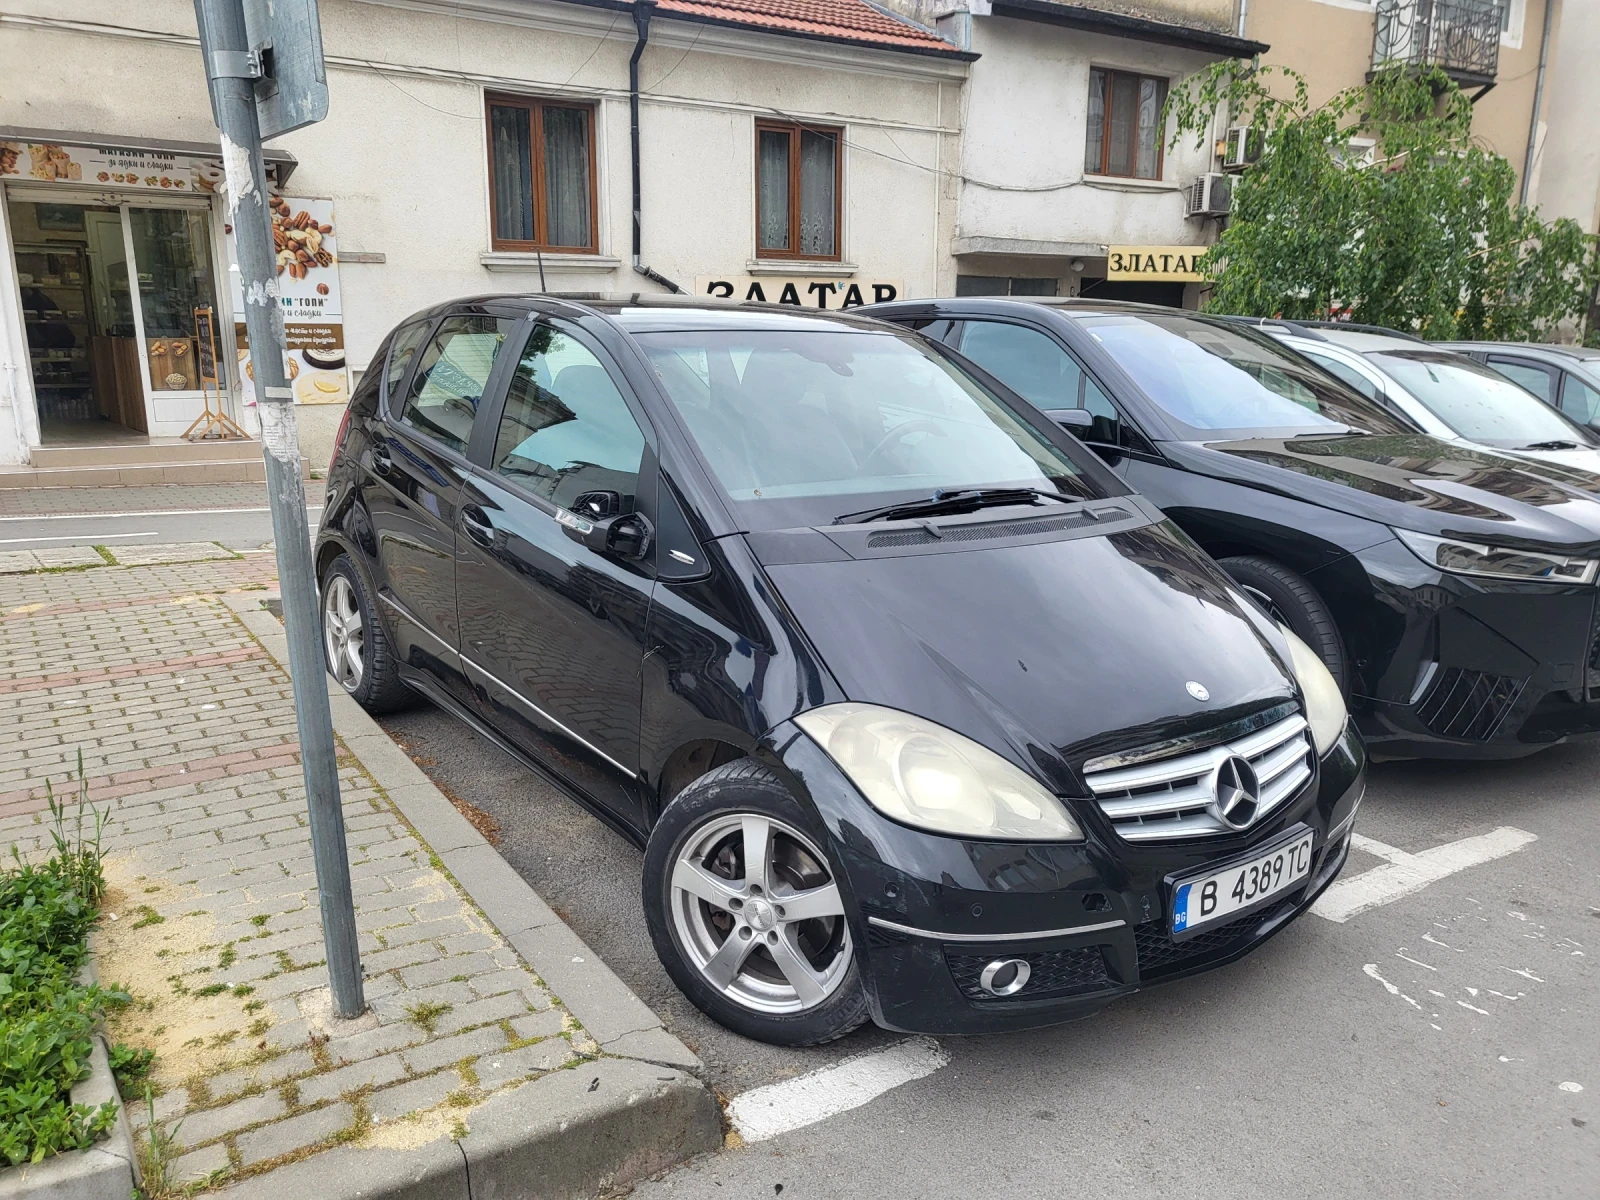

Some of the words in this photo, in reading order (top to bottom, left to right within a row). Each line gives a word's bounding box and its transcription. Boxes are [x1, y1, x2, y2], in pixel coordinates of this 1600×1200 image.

[119, 159, 138, 170] ядки
[147, 161, 174, 172] сладки
[294, 309, 322, 319] сладки
[1231, 854, 1283, 903] 4389
[1174, 911, 1187, 925] BG
